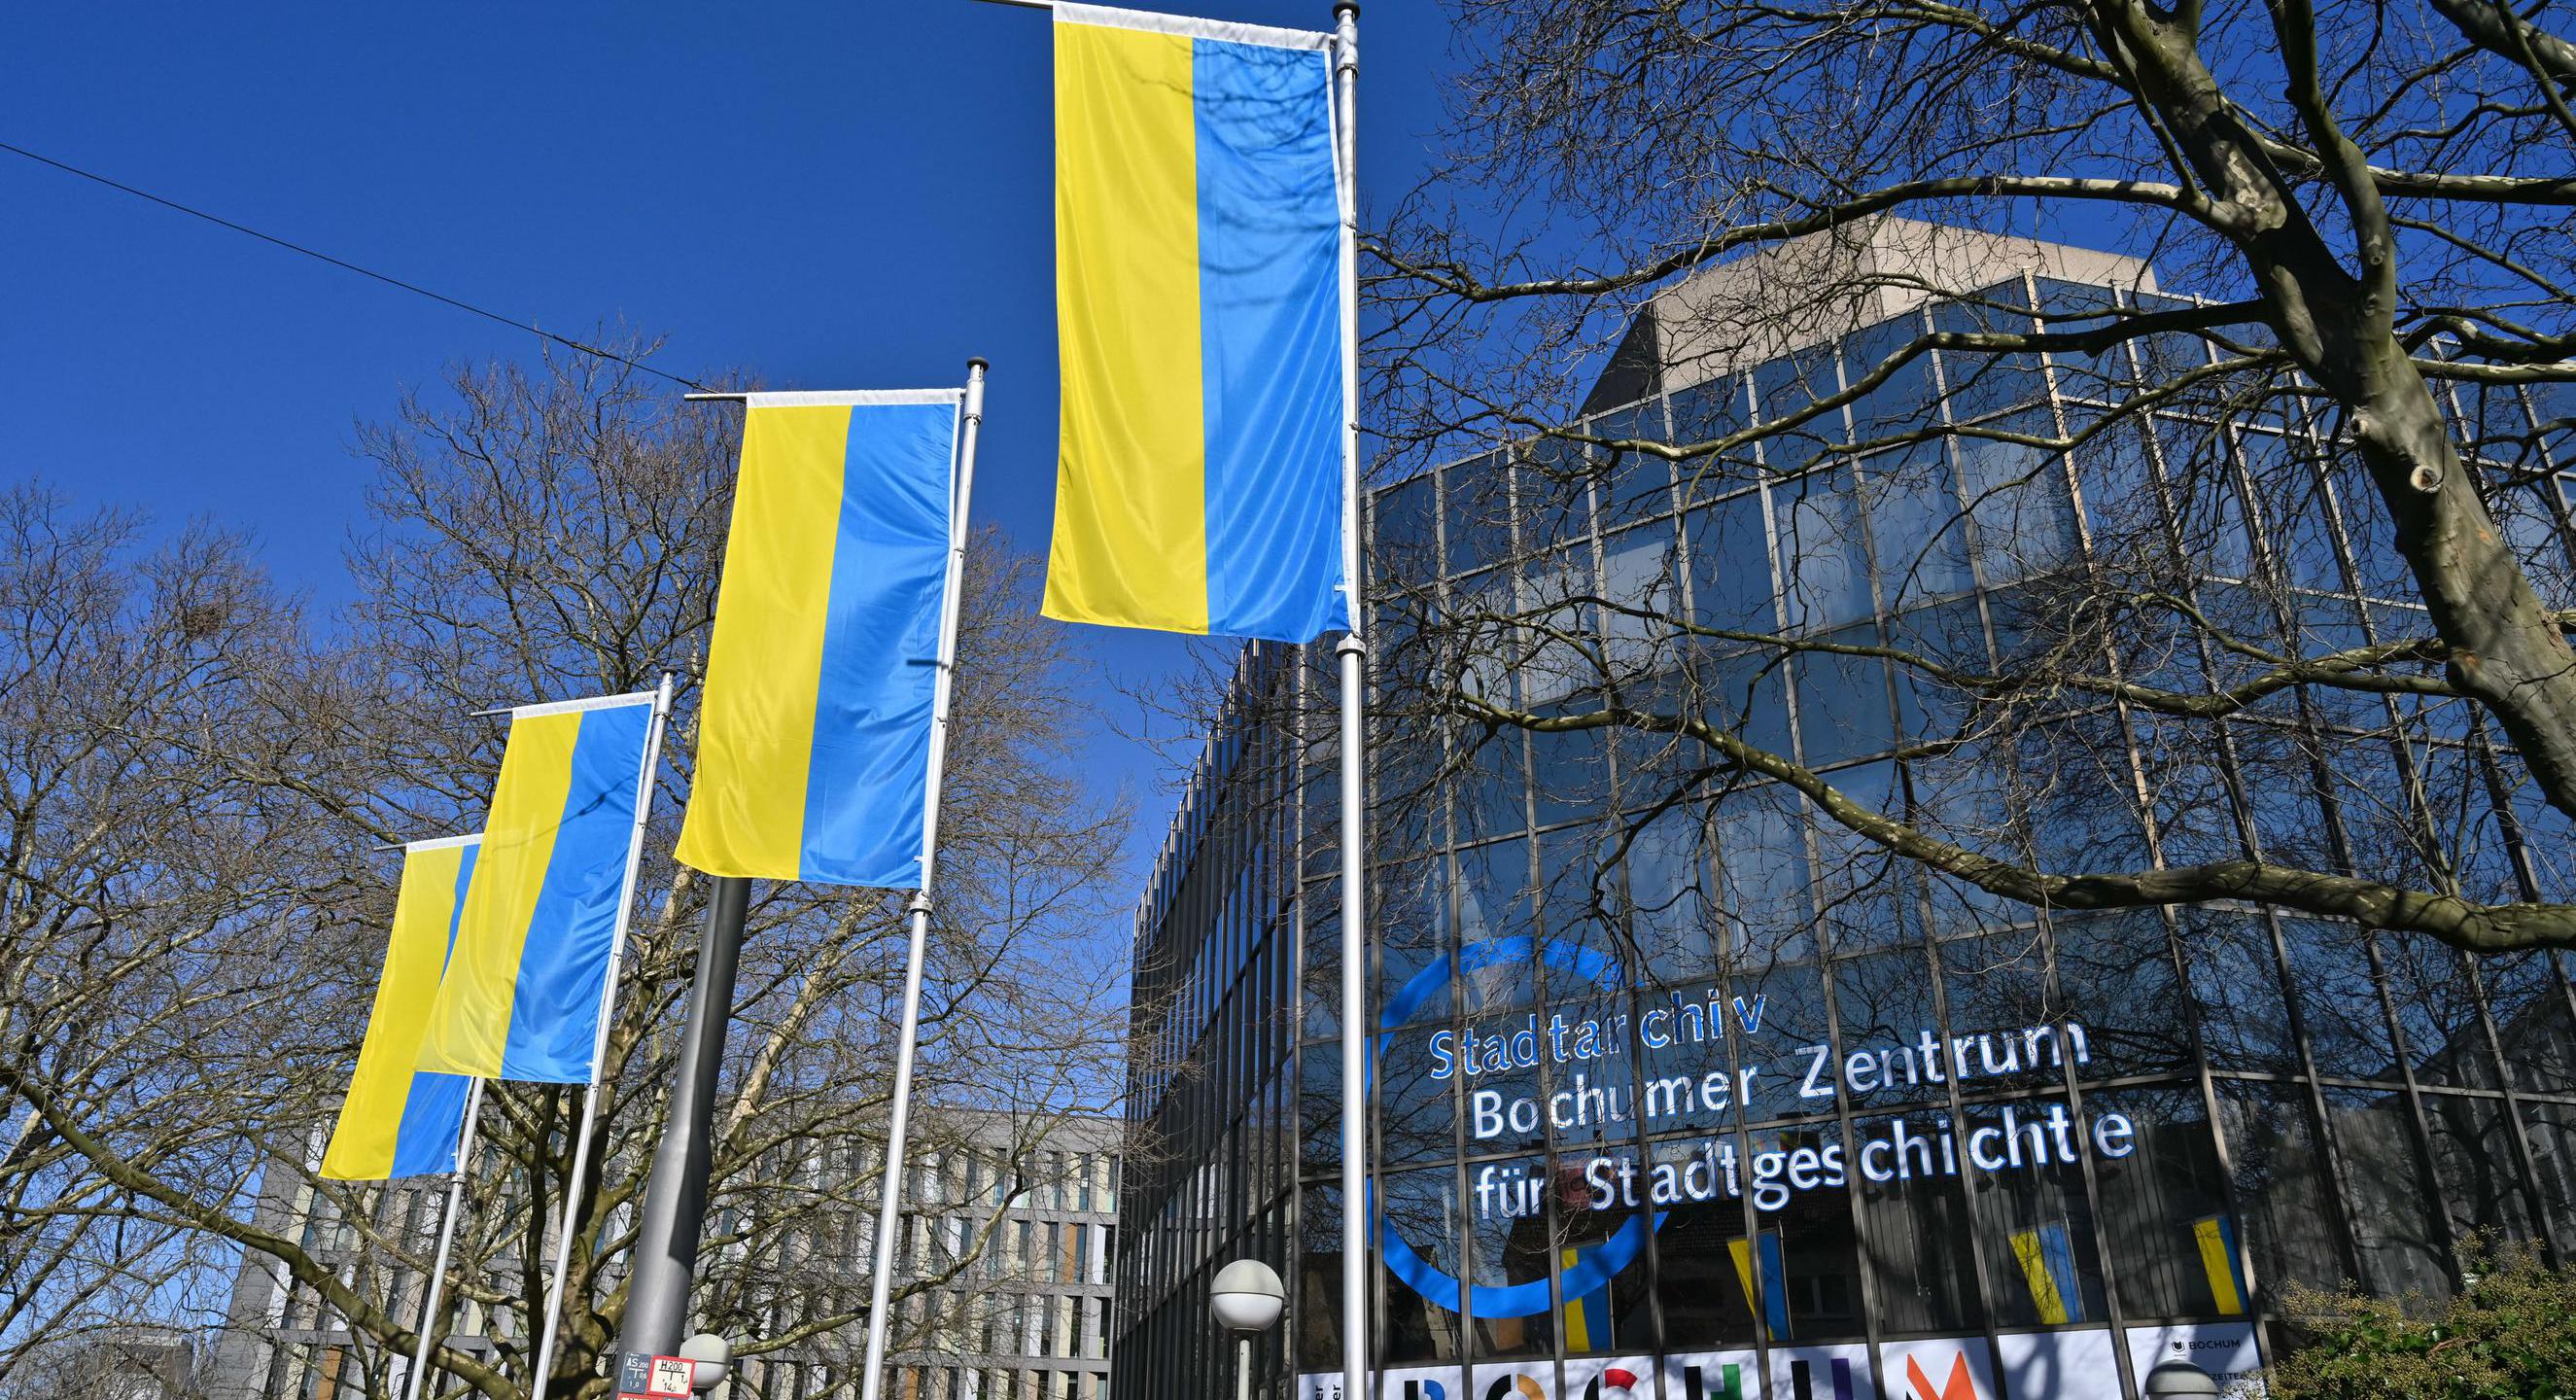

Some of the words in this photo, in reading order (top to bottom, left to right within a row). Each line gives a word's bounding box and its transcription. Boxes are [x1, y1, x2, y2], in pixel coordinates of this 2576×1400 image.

[1429, 989, 1766, 1079] Stadtarchiv
[1472, 1065, 1758, 1139] Bochumer
[1794, 1021, 2090, 1099] Zentrum
[1476, 1164, 1544, 1220] für
[1584, 1103, 2134, 1211] Stadtgeschichte
[2188, 1339, 2241, 1350] BOCHUM
